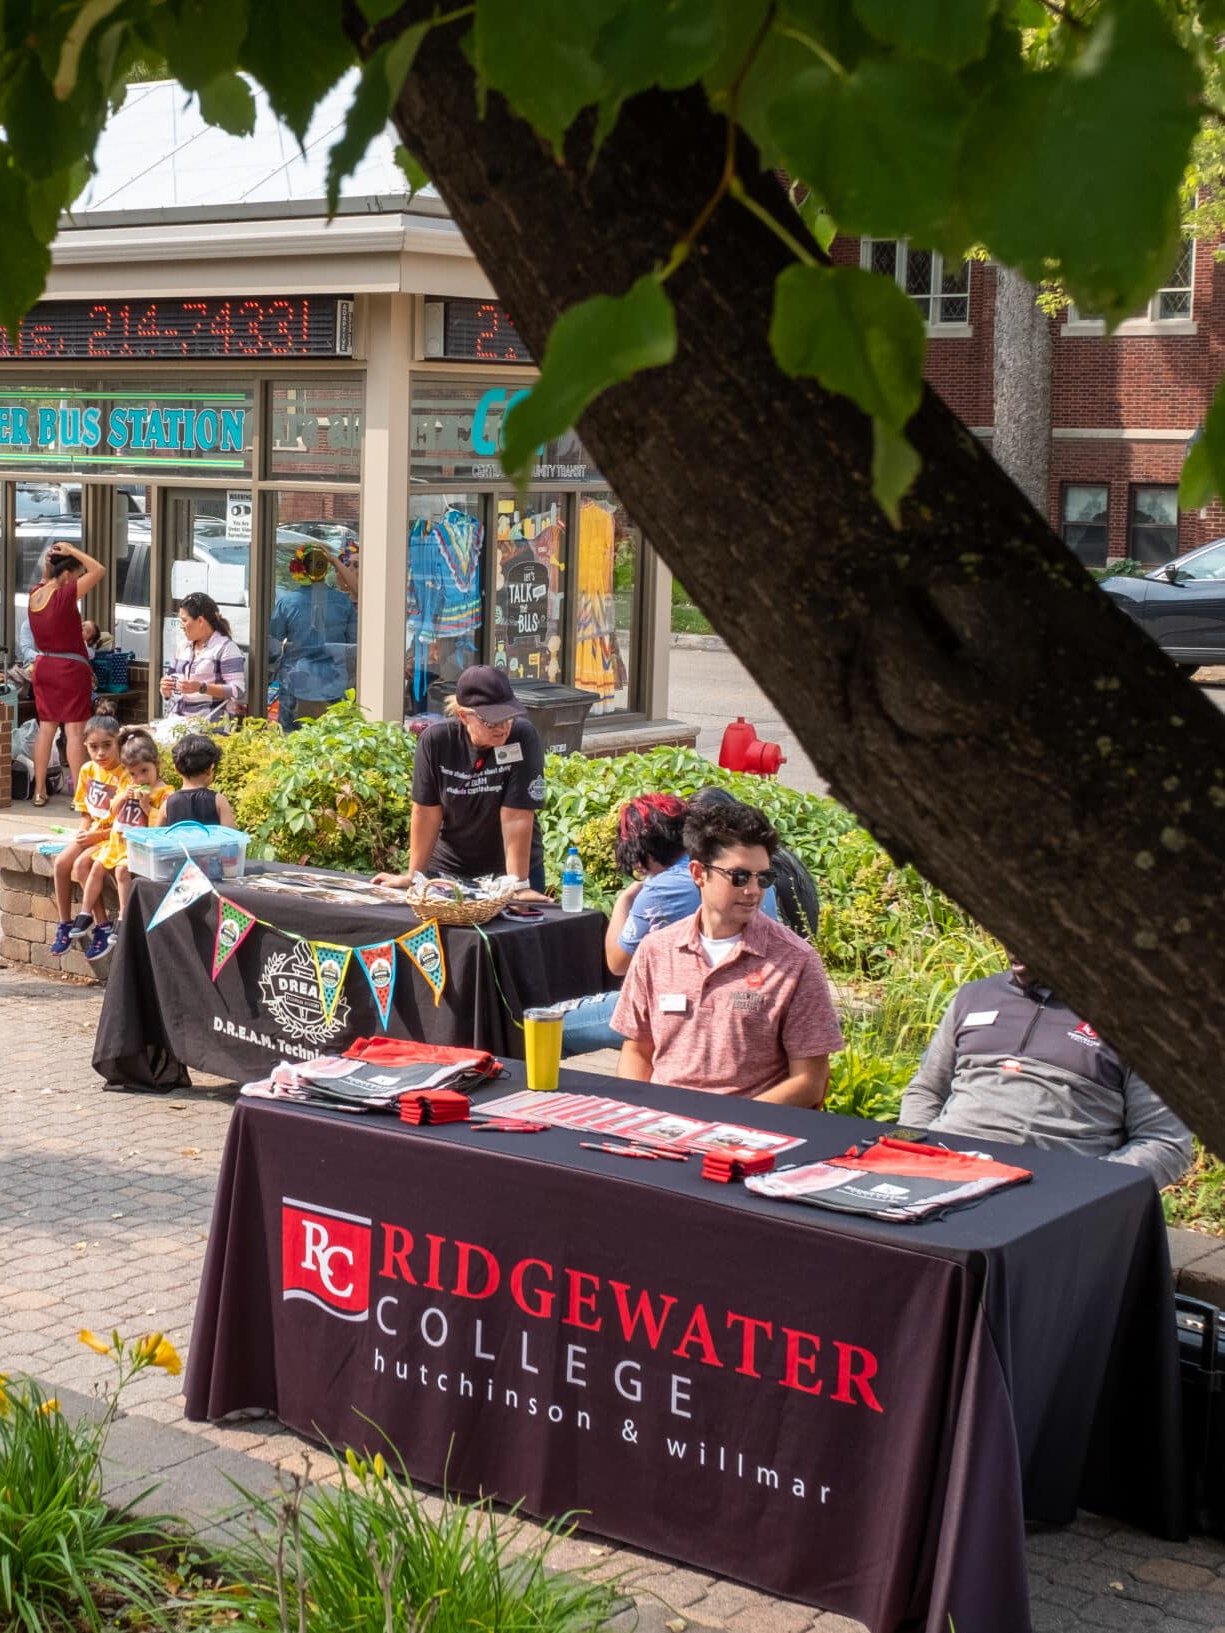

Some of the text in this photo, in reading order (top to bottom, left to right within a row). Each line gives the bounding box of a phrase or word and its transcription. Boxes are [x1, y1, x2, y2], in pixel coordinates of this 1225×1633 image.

[38, 406, 102, 448] BUS
[107, 407, 246, 451] STATION
[509, 583, 533, 604] TALK
[518, 612, 539, 634] BUS
[278, 977, 319, 1000] DREA
[213, 1015, 276, 1050] D.R.E.A.M.
[301, 1220, 355, 1298] RC
[378, 1221, 884, 1414] RIDGEWATER
[376, 1295, 692, 1418] COLLEGE
[373, 1347, 831, 1504] hutchinson & willmar
